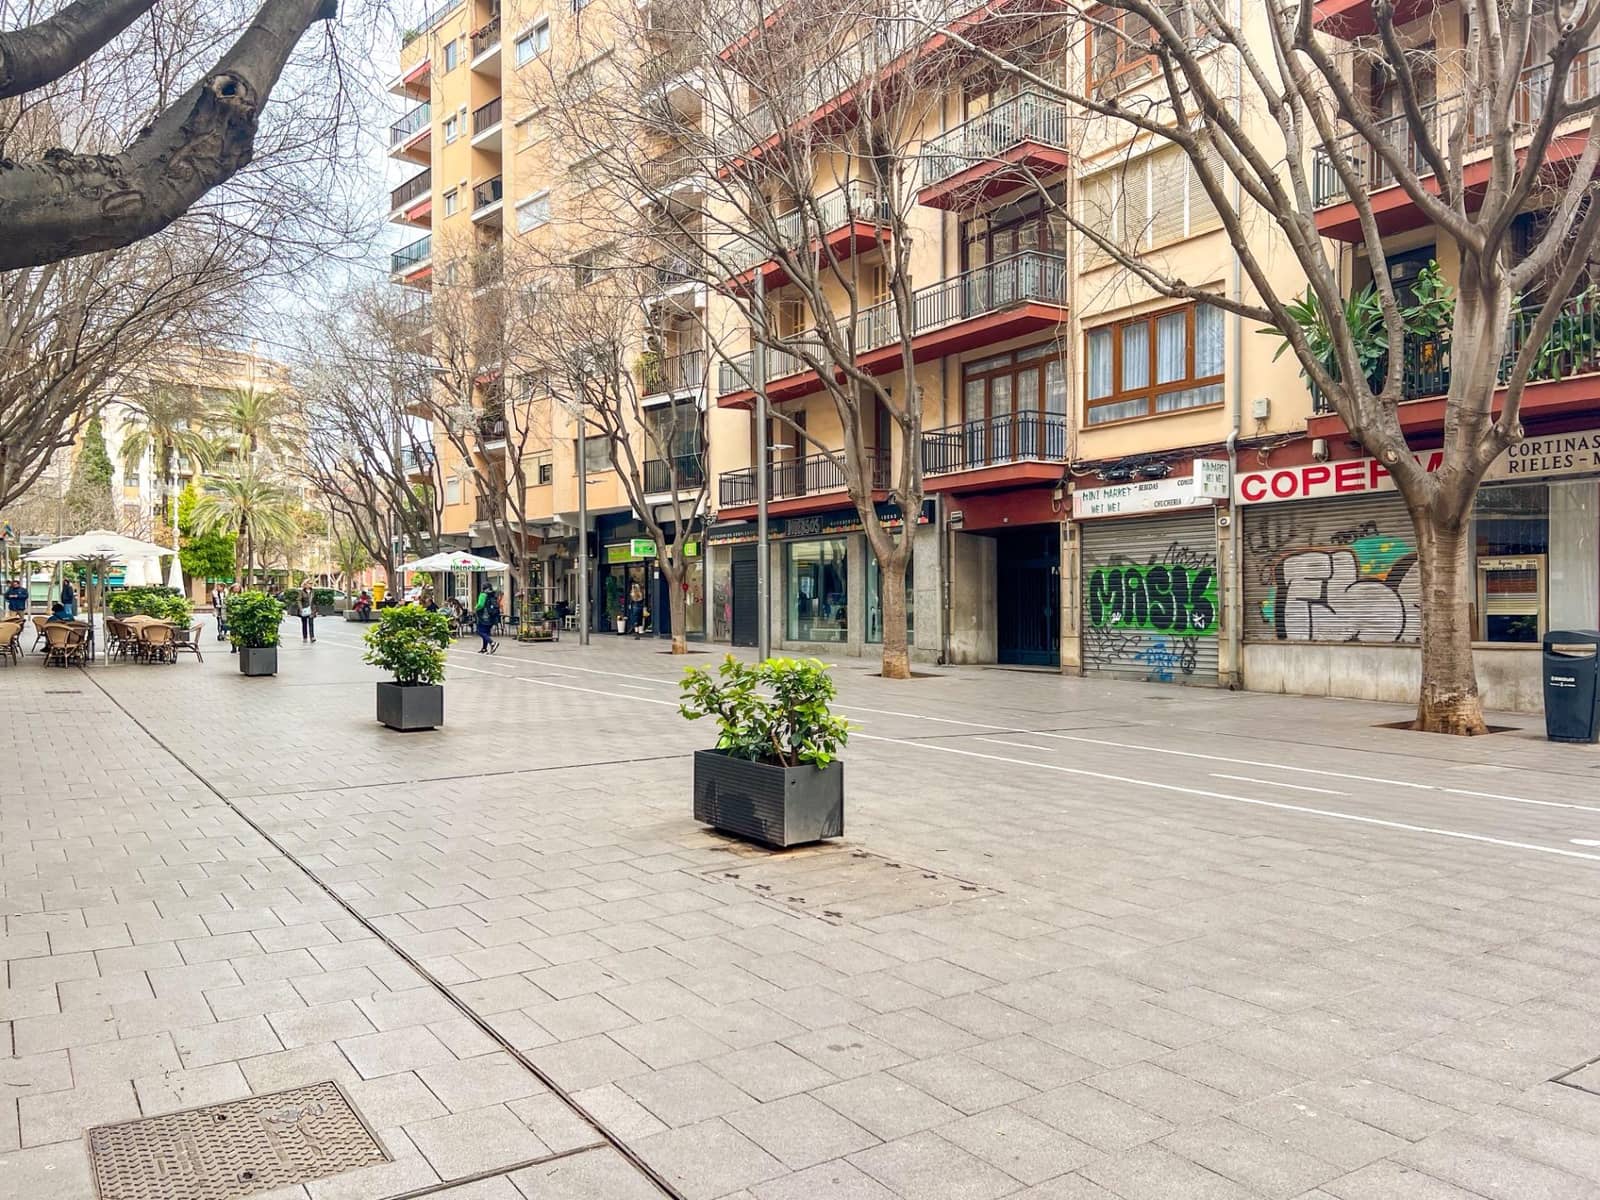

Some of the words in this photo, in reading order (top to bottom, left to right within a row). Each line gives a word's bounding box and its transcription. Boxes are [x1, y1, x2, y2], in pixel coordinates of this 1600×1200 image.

[1508, 435, 1600, 458] CORTINAS
[1508, 454, 1574, 474] RIELES
[1082, 489, 1100, 502] MINI
[1103, 486, 1132, 499] MARKET
